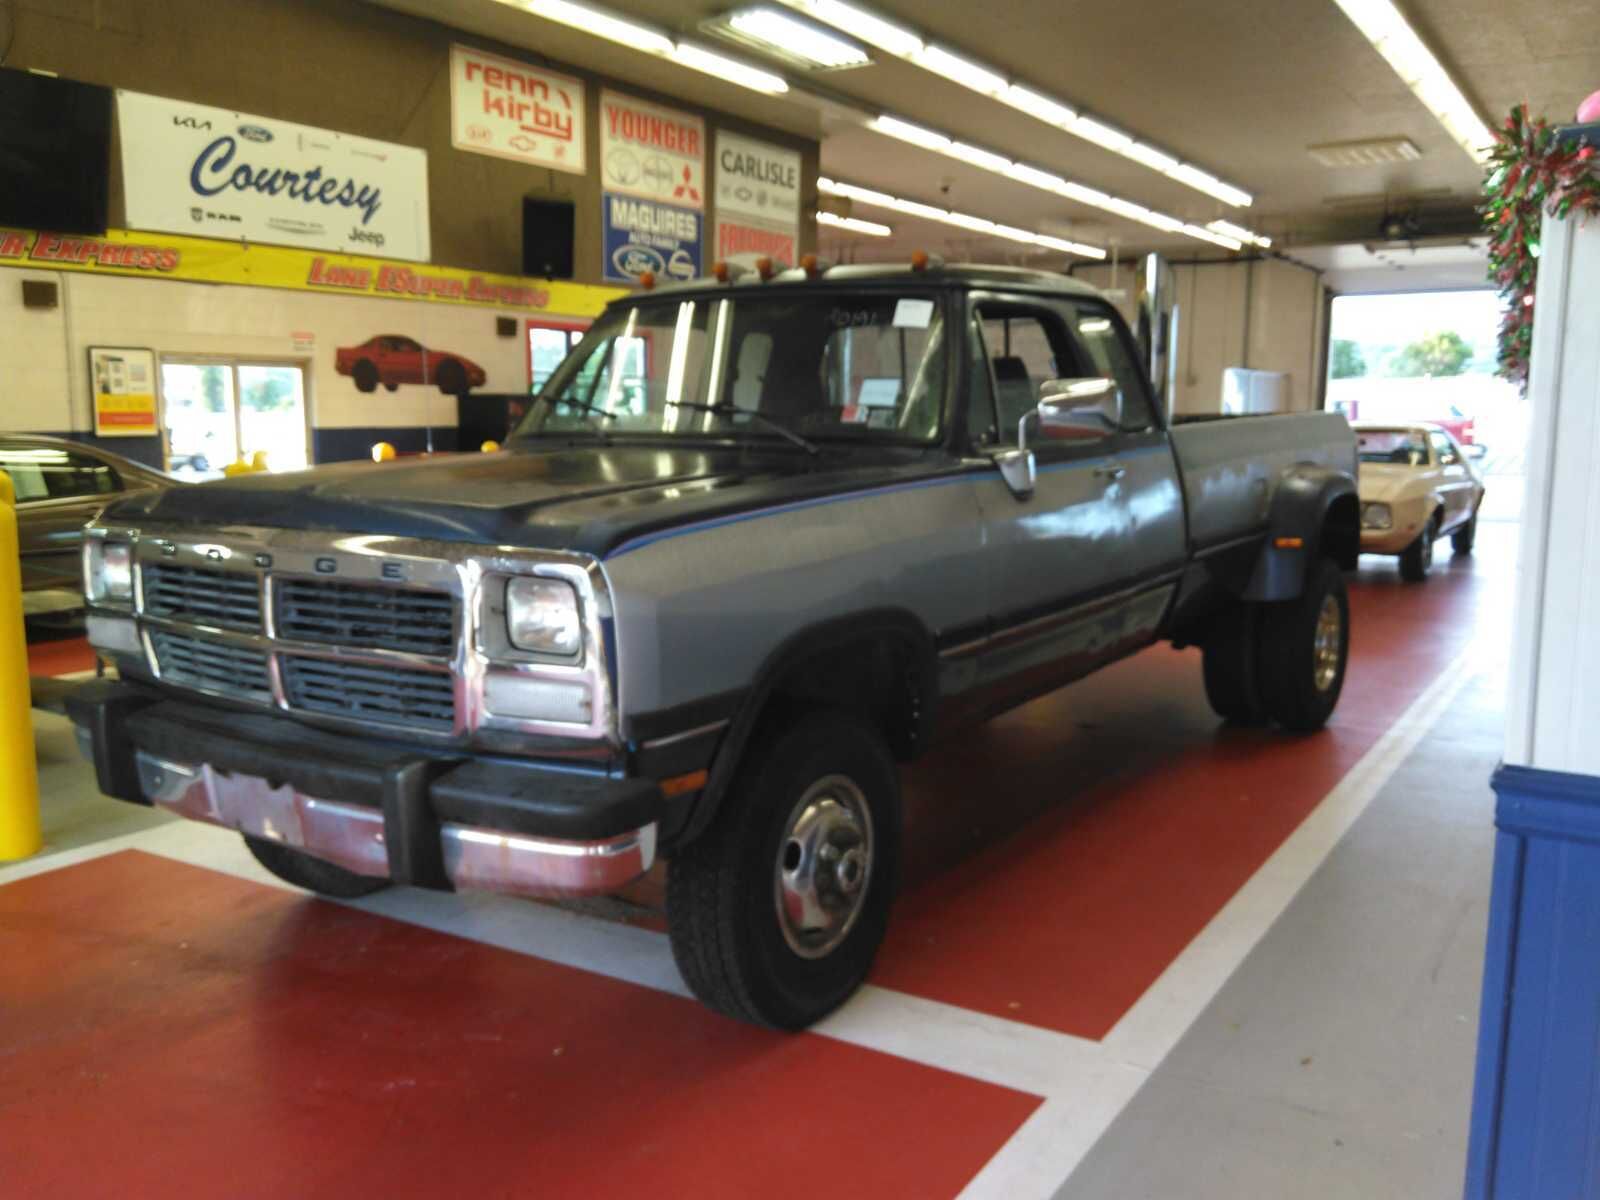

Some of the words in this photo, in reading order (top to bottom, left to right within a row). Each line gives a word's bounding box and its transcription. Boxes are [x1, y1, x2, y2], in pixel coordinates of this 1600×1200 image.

[465, 60, 550, 101] renn
[173, 116, 212, 131] KIA
[483, 87, 573, 142] kirby
[607, 104, 700, 155] YOUNGER
[189, 135, 382, 226] Courtesy
[720, 148, 796, 190] CARLISLE
[348, 226, 386, 248] Jeep
[610, 198, 698, 243] MAGUIRES
[29, 231, 179, 272] EXPRESS
[162, 541, 404, 579] DODGE
